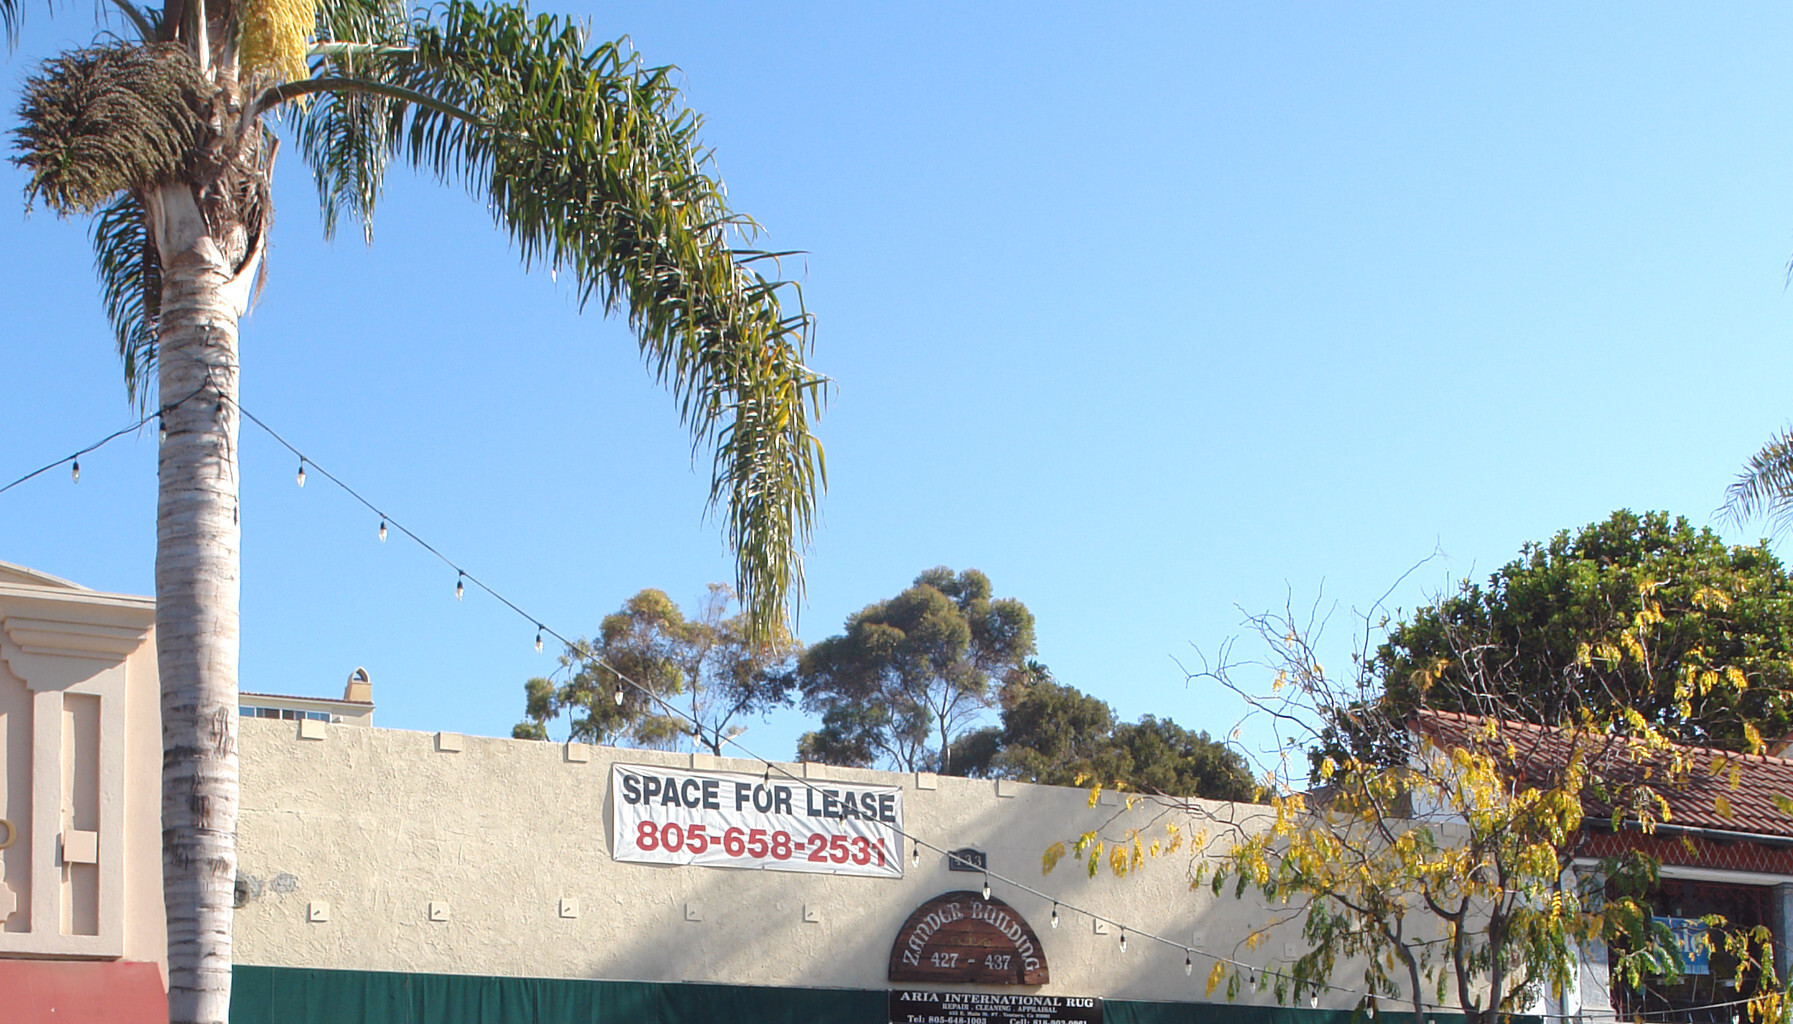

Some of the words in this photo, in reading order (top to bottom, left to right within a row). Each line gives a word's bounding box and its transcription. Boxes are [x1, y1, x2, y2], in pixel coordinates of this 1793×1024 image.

[623, 774, 720, 809] SPACE
[736, 782, 792, 815] FOR
[807, 788, 896, 823] LEASE
[636, 820, 885, 867] 805-658-2531
[903, 902, 963, 966] ZANDER
[971, 901, 1040, 971] BUILDING
[931, 952, 959, 968] 427
[984, 955, 1011, 970] 437
[900, 991, 939, 1002] ARIA
[944, 993, 1061, 1006] INTERNATIONAL
[1065, 998, 1094, 1008] RUG
[942, 1002, 969, 1010] REPAIR
[975, 1004, 1011, 1012] CLEANING
[1017, 1006, 1057, 1014] APPRAISAL
[907, 1014, 925, 1023] Tel:
